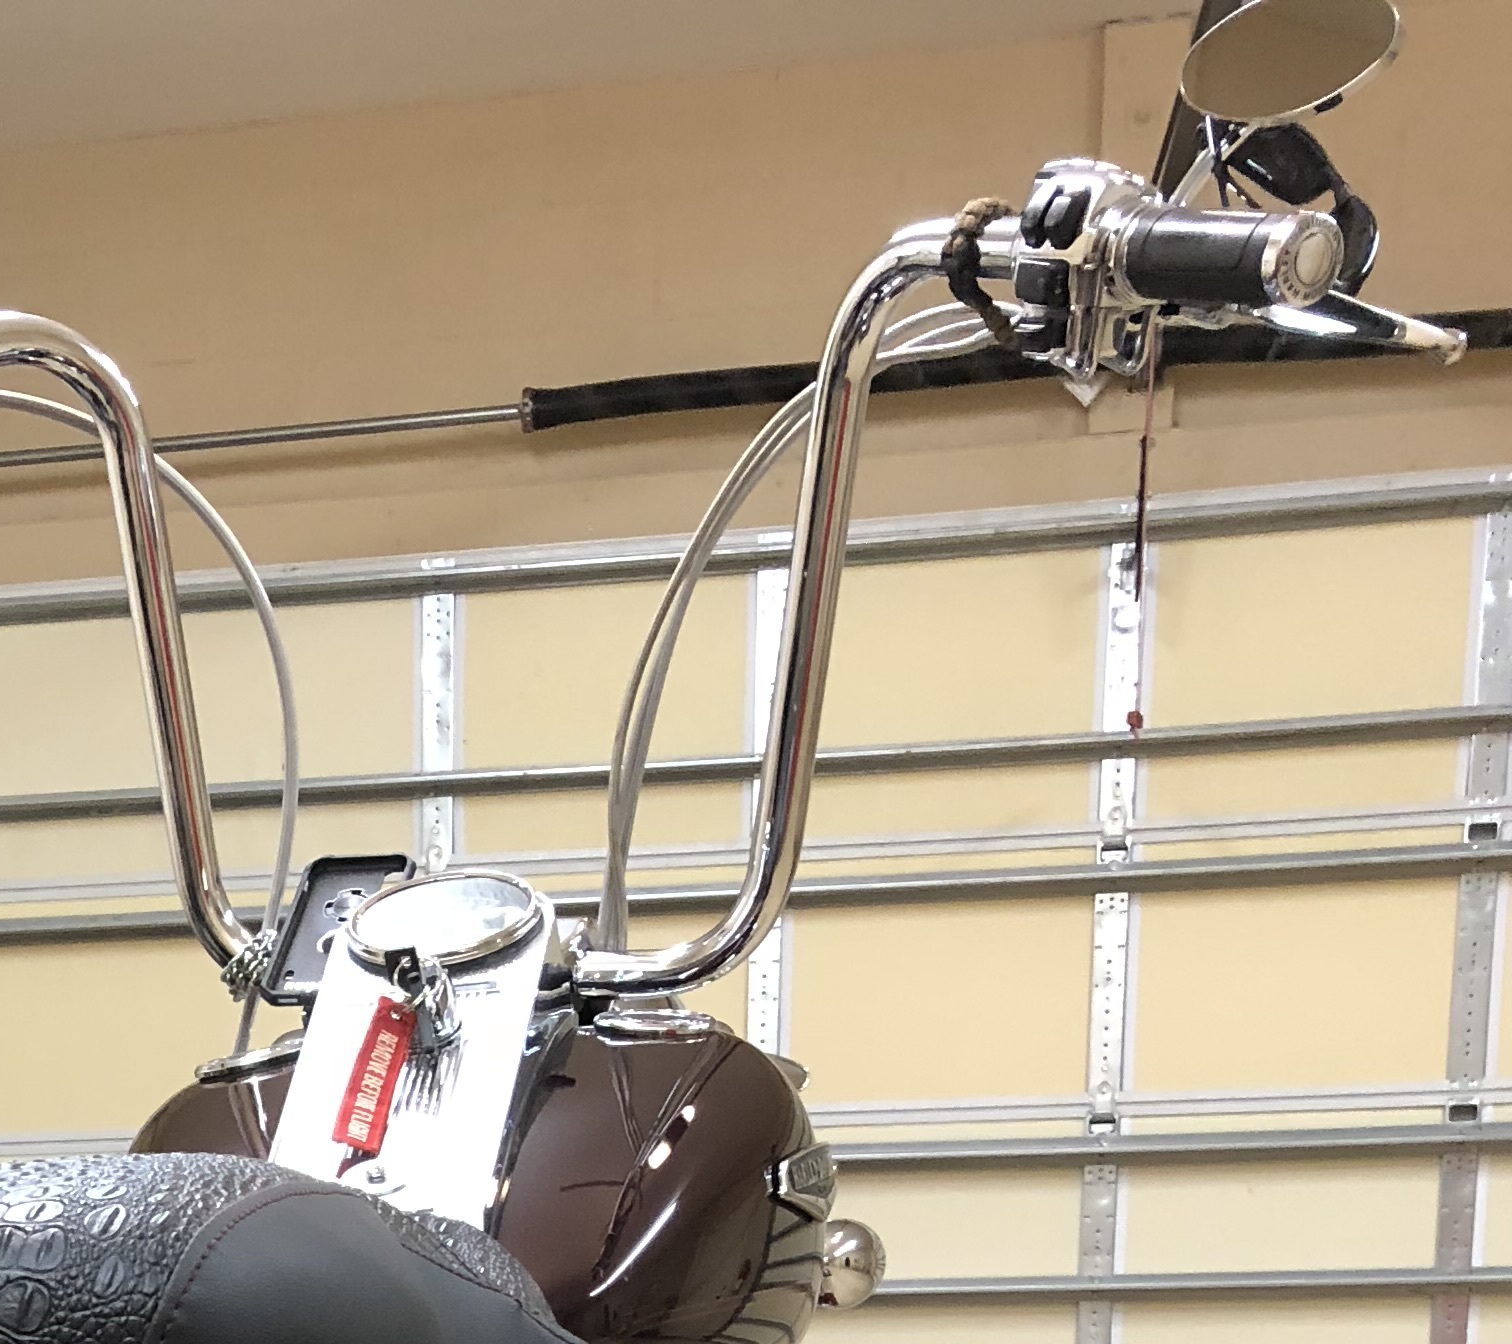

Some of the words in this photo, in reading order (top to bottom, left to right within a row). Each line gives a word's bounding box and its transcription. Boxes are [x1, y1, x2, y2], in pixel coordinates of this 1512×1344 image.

[367, 1029, 399, 1078] REMOVE
[354, 1072, 383, 1113] BEFORE
[347, 1109, 374, 1142] FLIGHT
